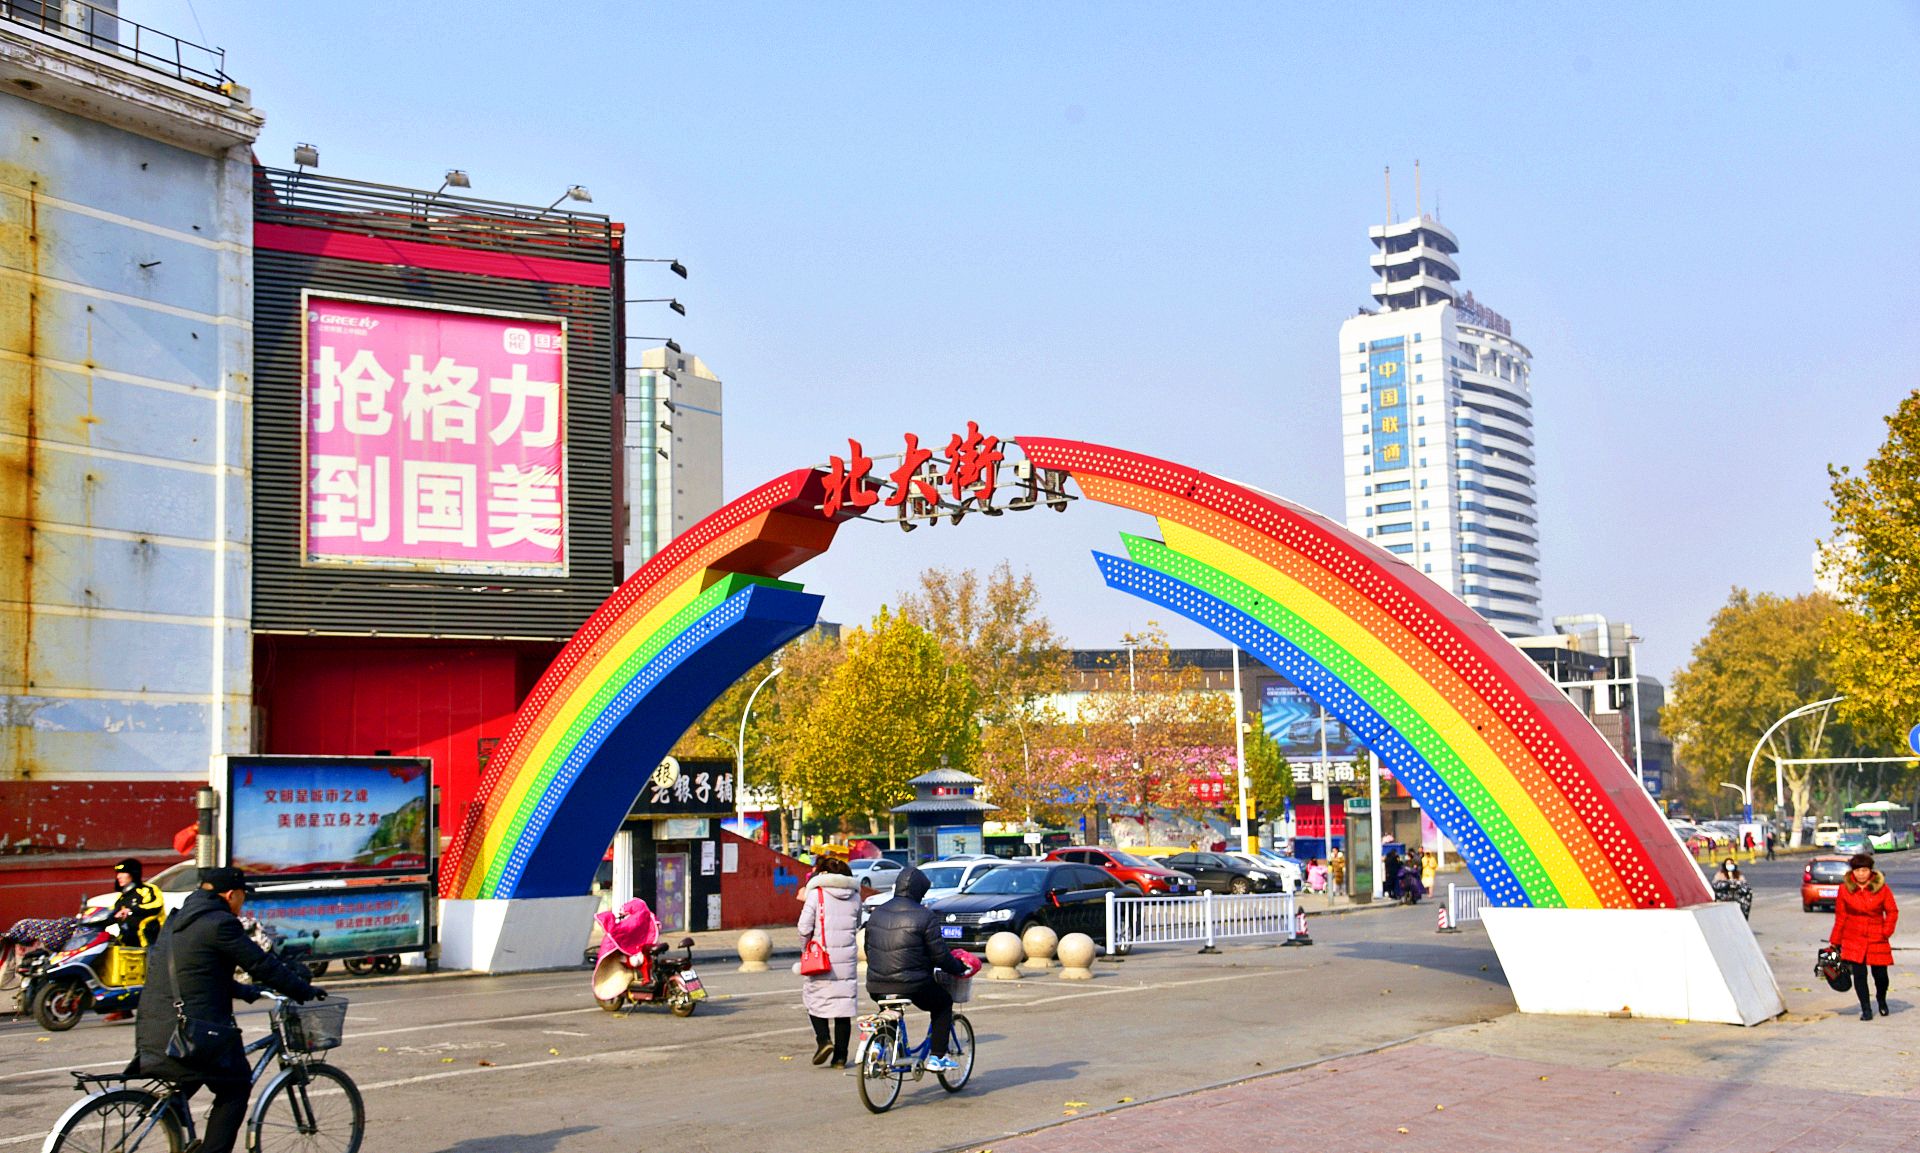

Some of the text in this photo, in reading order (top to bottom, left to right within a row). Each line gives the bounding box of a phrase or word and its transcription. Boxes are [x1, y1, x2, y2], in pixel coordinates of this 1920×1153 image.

[311, 345, 560, 448] 抢格力
[1378, 360, 1402, 463] 中国联通
[310, 455, 562, 551] 到国美
[821, 420, 1004, 518] 北大街
[264, 788, 369, 804] 文明是城市之魂
[278, 811, 380, 829] 美德是立身之本
